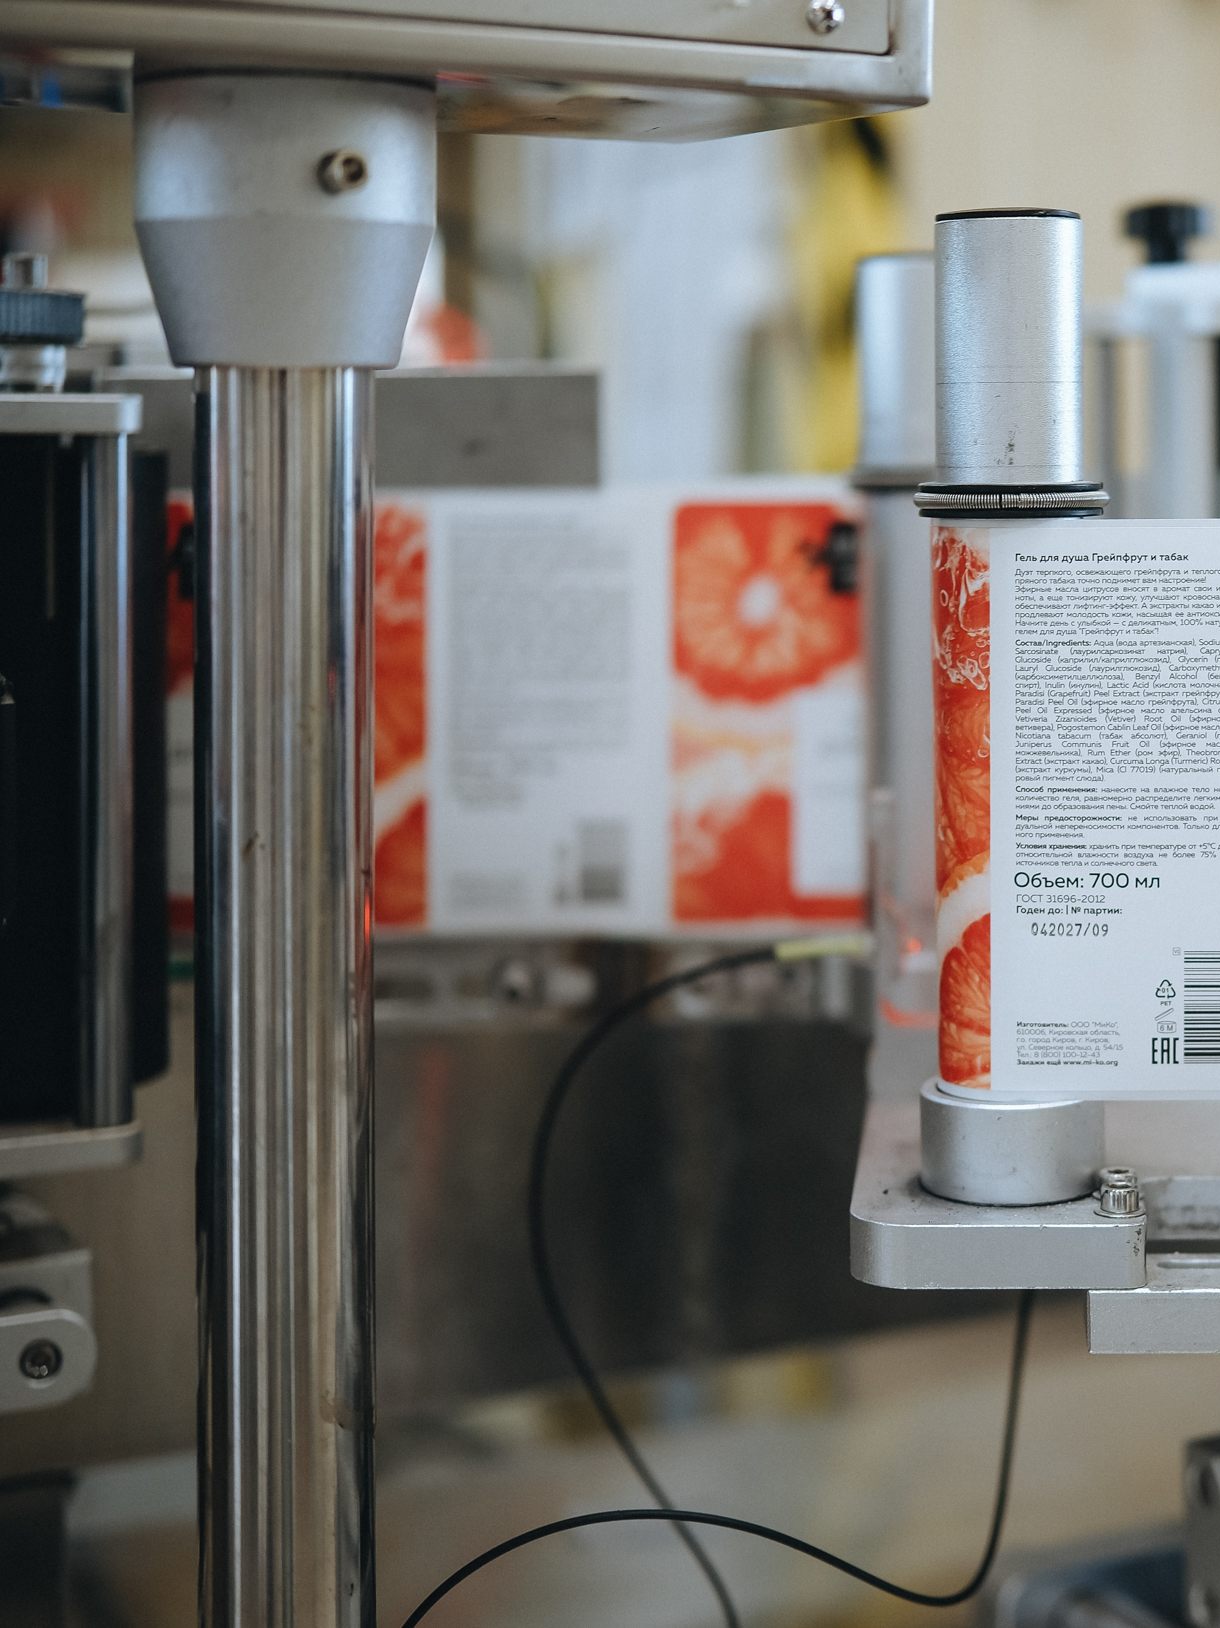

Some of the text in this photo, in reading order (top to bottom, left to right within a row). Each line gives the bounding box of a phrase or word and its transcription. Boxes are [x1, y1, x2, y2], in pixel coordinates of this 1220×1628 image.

[1015, 553, 1038, 561] Гель
[1061, 555, 1089, 564] душа
[1092, 553, 1148, 563] Грейпфрут
[1159, 553, 1189, 561] табак
[1014, 568, 1034, 577] Дуэт
[1134, 568, 1181, 577] грейпфрута
[1015, 585, 1052, 594] Эфирные
[1077, 619, 1111, 628] улыбкой
[1093, 639, 1114, 648] Aqua
[1115, 638, 1138, 647] (вода
[1142, 689, 1179, 698] (экстракт
[1015, 723, 1055, 733] ветивера),
[1056, 724, 1106, 732] Pogostemon
[1162, 723, 1200, 732] (эфирное
[1015, 814, 1039, 823] Меры
[1014, 872, 1160, 888] Объем: 700 мл
[1016, 894, 1106, 903] ГОСТ 31696-2012
[1016, 906, 1046, 914] Годен
[1047, 906, 1064, 914] до:
[1031, 922, 1109, 937] 042027/09
[1152, 1038, 1179, 1064] EAC
[1046, 1058, 1061, 1066] ещё
[1063, 1058, 1118, 1067] www.mi-ko.org
